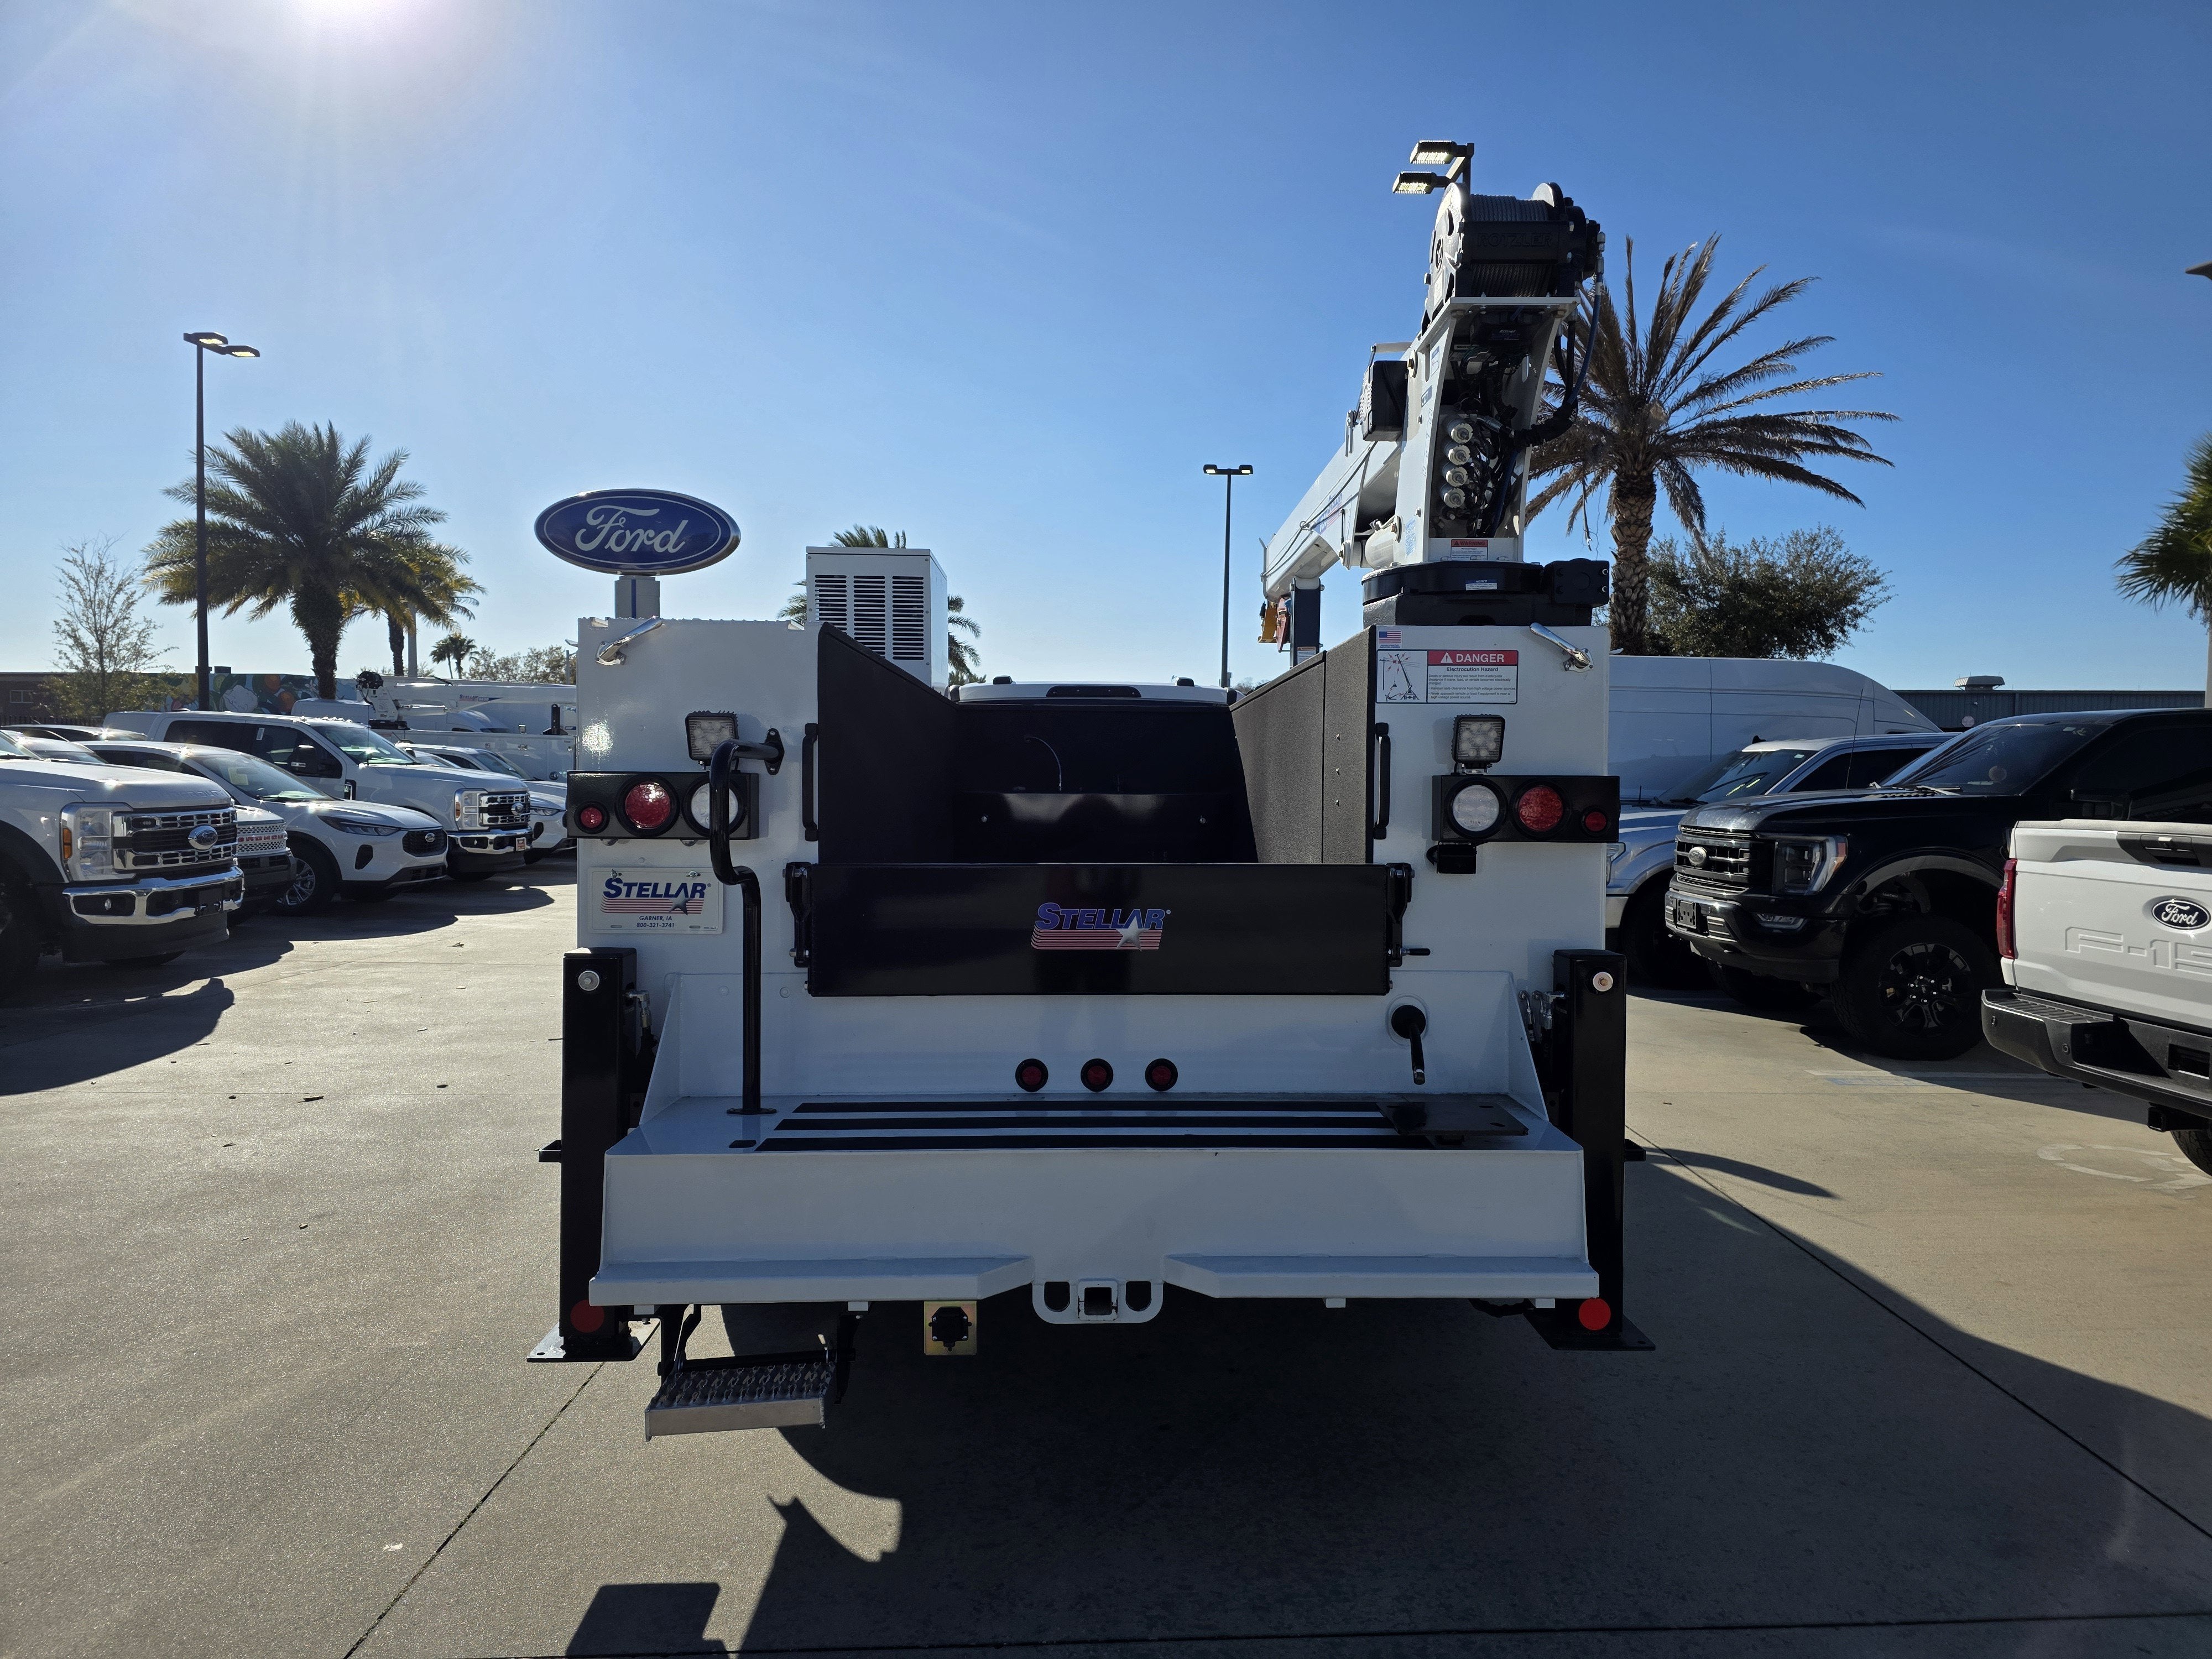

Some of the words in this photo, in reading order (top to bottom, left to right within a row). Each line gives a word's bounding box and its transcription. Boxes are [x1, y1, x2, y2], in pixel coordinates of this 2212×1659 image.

[1477, 232, 1552, 247] ROTZLER
[575, 505, 688, 553] Ford
[1456, 654, 1505, 662] DANGER
[603, 878, 707, 899] STELLAR
[1035, 902, 1166, 930] STELLAR
[2161, 903, 2199, 926] Ford
